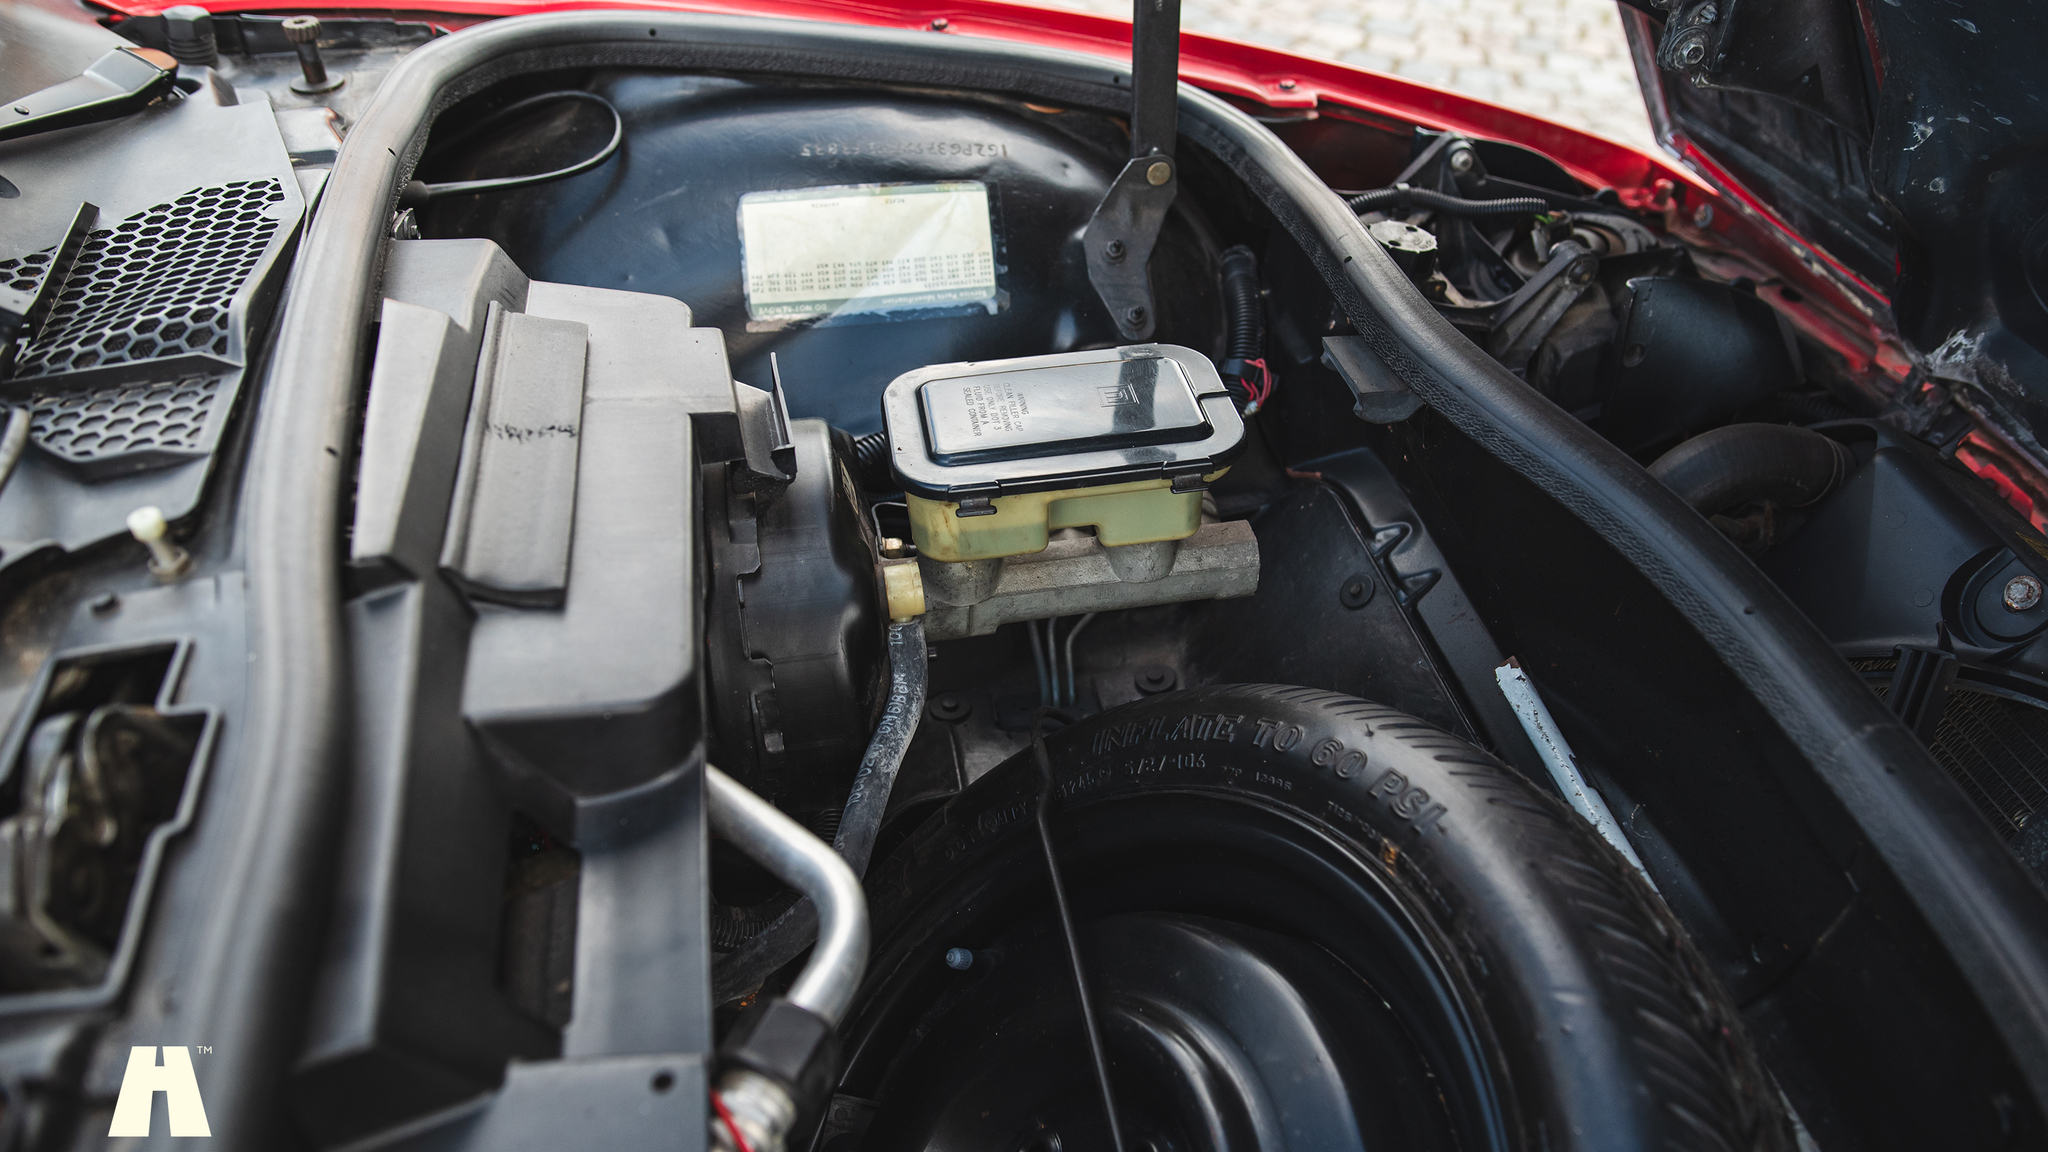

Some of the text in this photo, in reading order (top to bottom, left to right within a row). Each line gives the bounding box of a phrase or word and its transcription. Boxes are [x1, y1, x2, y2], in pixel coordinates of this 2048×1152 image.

[881, 289, 988, 305] Service Parts Identification
[795, 304, 812, 312] NOT
[814, 303, 827, 311] DO
[973, 385, 984, 401] FLUID
[982, 384, 993, 395] USE
[977, 402, 988, 419] FROM
[986, 396, 997, 410] ONLY
[1003, 382, 1024, 432] CLEAN FILLER CAP
[1017, 392, 1029, 415] WARNING
[962, 386, 982, 437] SEALED CONTAINER
[990, 412, 1001, 424] DOT
[999, 405, 1013, 432] REMOVING
[1092, 713, 1449, 836] INFLATE TO 60 PSI
